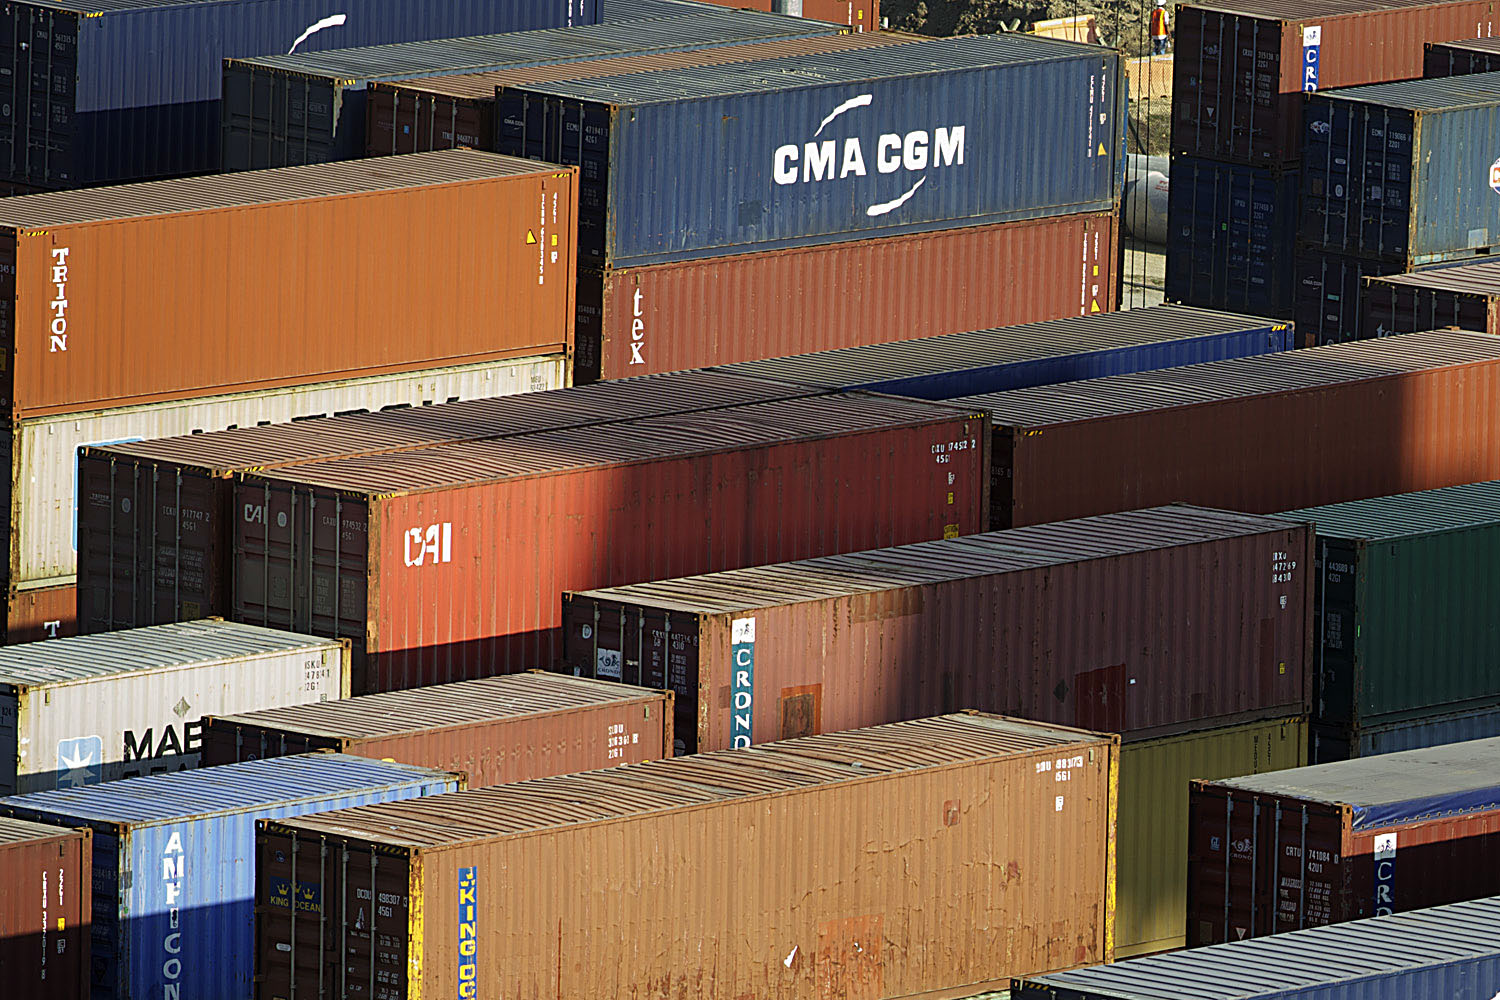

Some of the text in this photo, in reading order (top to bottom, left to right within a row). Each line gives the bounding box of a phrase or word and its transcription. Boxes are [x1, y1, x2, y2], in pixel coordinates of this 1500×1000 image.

[773, 125, 966, 186] CMA CGM
[50, 248, 69, 351] TRITON
[629, 288, 646, 365] tex
[403, 522, 453, 567] CAI
[124, 722, 202, 763] MAE
[1286, 846, 1300, 858] CRTU
[270, 897, 289, 908] KING
[377, 906, 393, 918] 45G1
